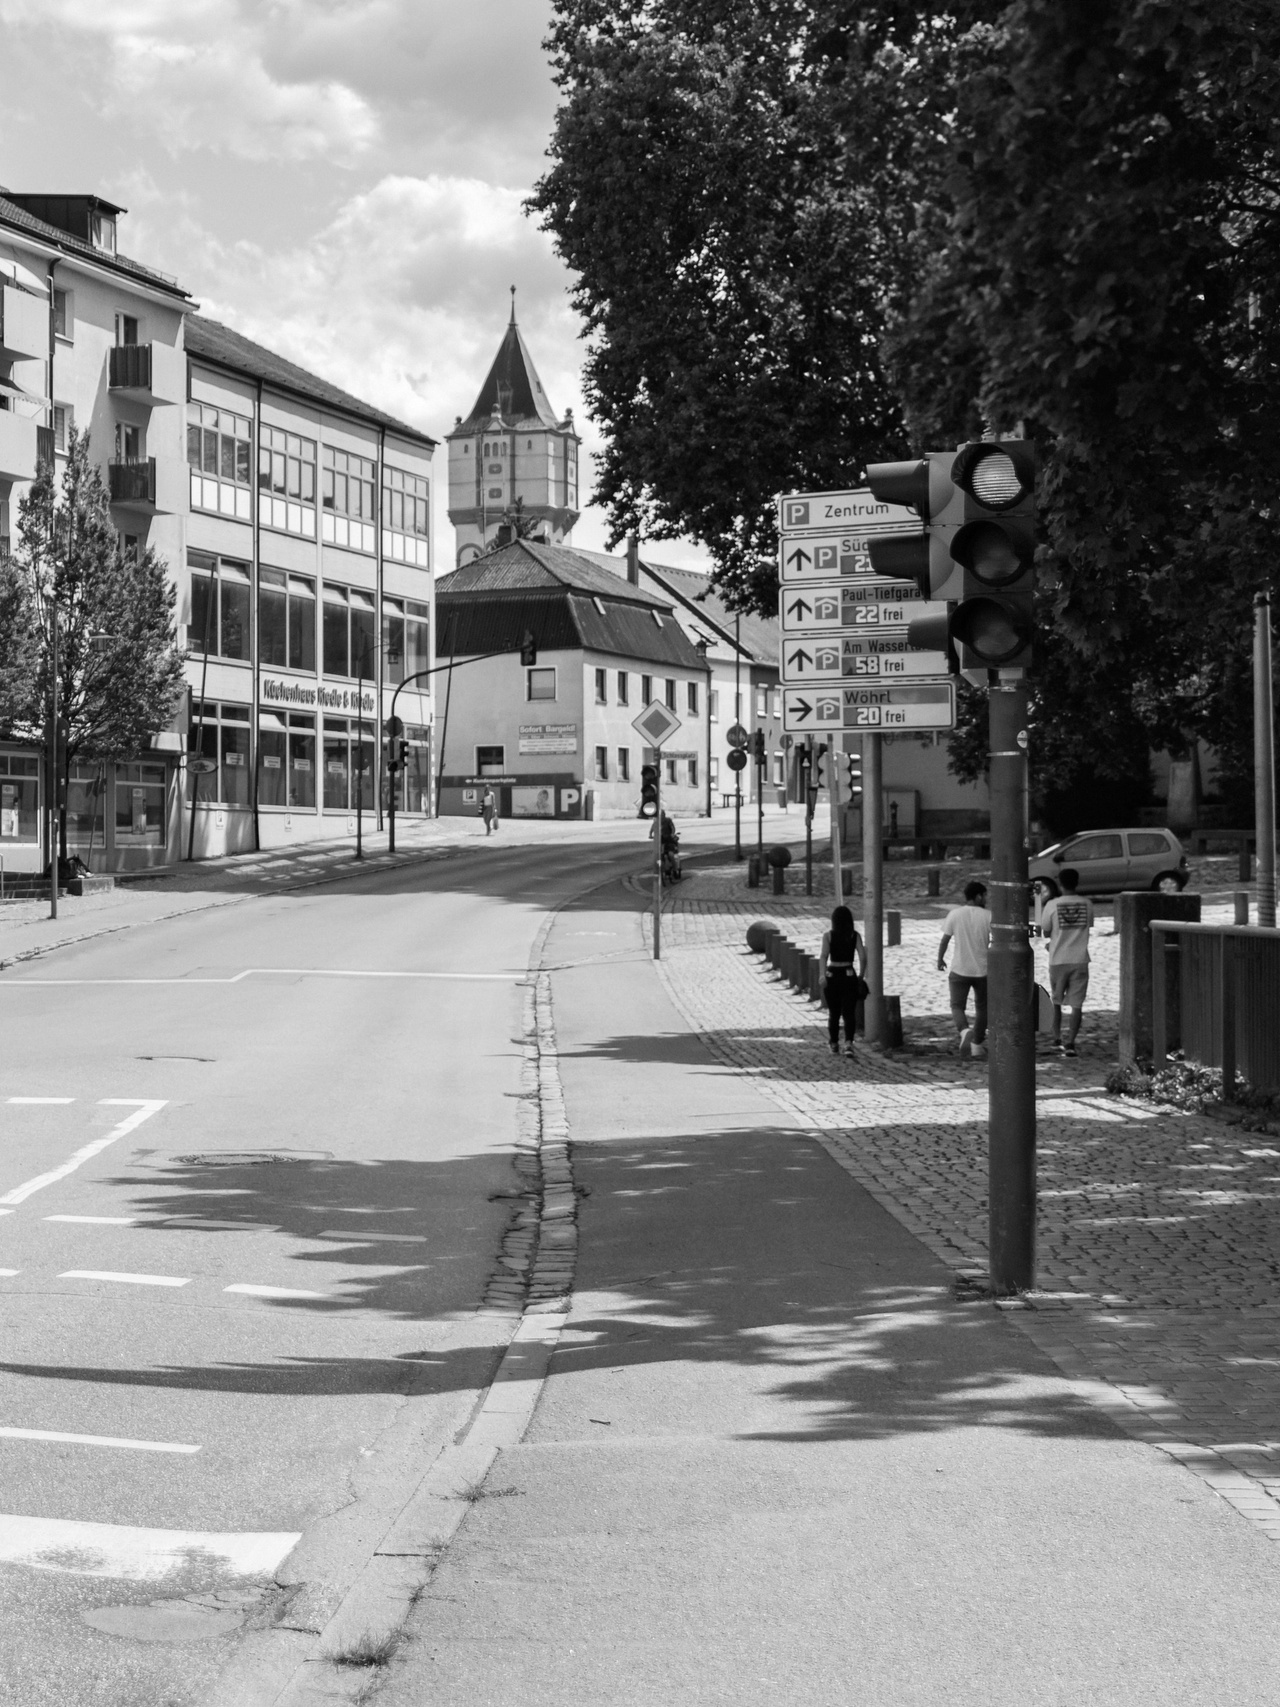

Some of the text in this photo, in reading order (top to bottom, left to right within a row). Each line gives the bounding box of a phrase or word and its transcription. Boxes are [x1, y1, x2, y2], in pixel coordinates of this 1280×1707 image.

[824, 504, 889, 518] Zentrum
[842, 586, 921, 602] Paul-Tiefgara
[856, 606, 903, 624] 22 frei
[844, 641, 862, 654] Am
[856, 656, 904, 674] 58 frei
[264, 679, 316, 704] Küchenhaus
[844, 690, 892, 704] Wöhrl
[857, 707, 906, 725] 20 frei
[560, 788, 580, 812] P
